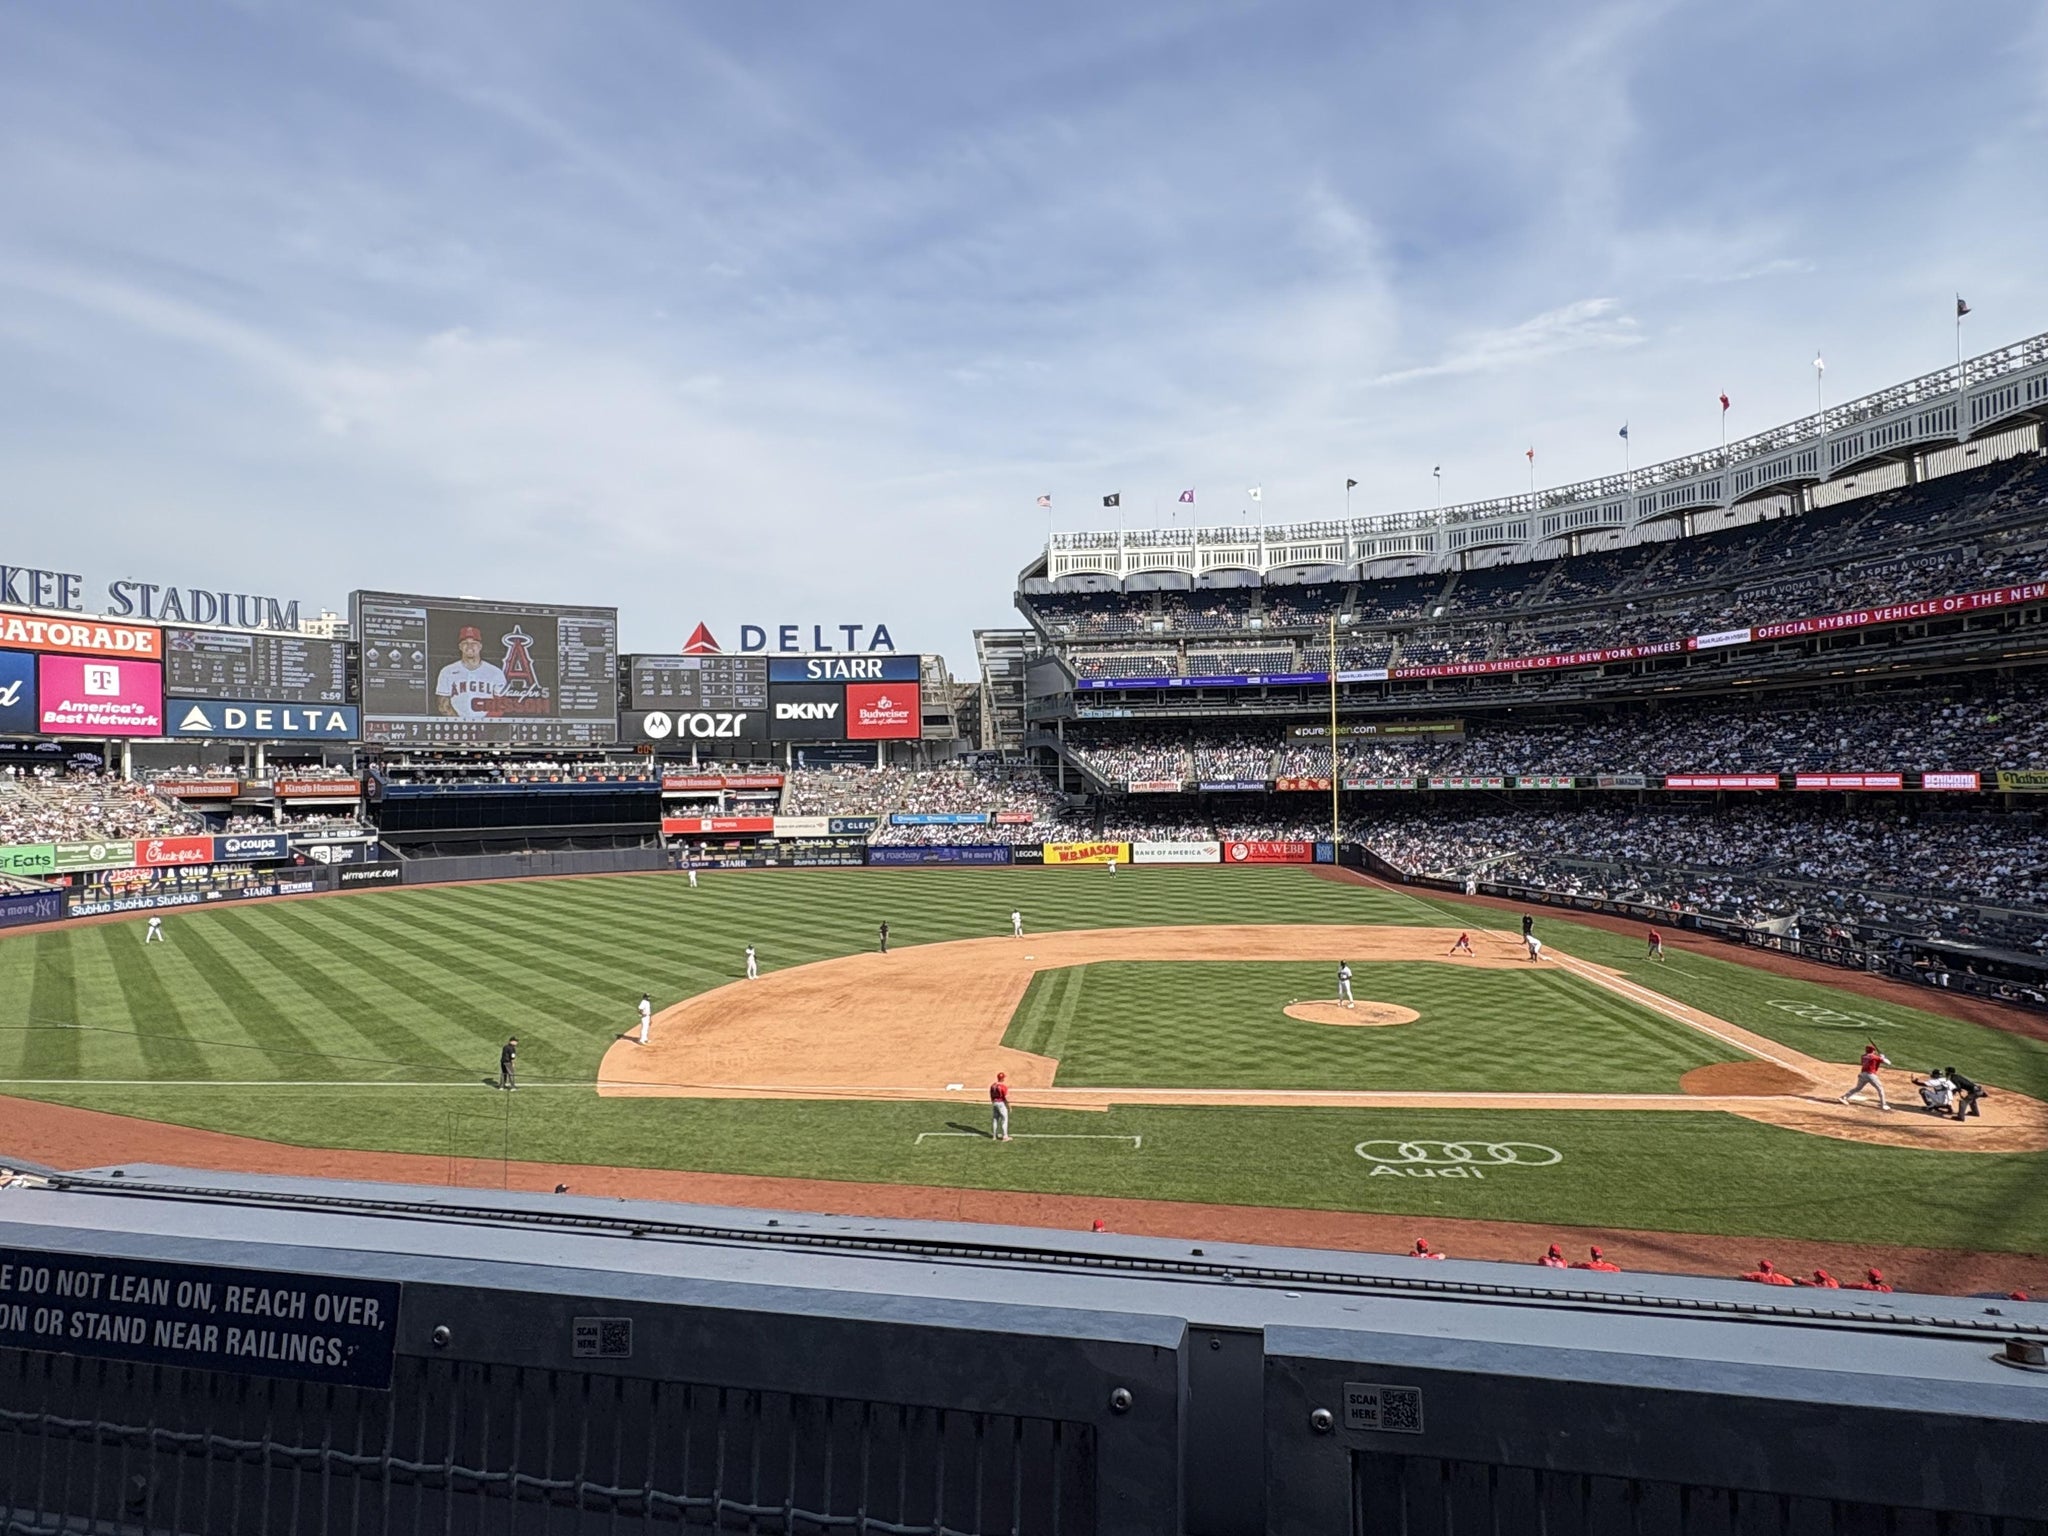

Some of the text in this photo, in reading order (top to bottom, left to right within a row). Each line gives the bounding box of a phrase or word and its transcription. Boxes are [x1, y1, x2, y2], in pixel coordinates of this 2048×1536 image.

[1858, 553, 1954, 578] ASPEN VODKA
[1737, 580, 1813, 601] ASPEN VODKA
[107, 580, 301, 632] STADIUM
[1758, 583, 2046, 638] OFFICIAL HYBRID VEHICLE OF THE NEW
[740, 624, 897, 651] DELTA
[1395, 641, 1682, 678] OFFICIAL HYBRID VEHICLE OF THE NEW YORK YANKEES
[807, 659, 883, 679] STARR
[320, 691, 341, 700] 3:59
[541, 687, 550, 698] 5
[58, 700, 145, 714] America's
[776, 703, 839, 719] DKNY
[859, 709, 909, 719] Budweiser
[43, 712, 158, 726] Best Network
[224, 708, 348, 732] DELTA
[677, 713, 747, 737] razr
[284, 784, 356, 794] King's Hawaiian
[241, 839, 275, 852] coupa
[1250, 844, 1269, 854] F.W.
[1271, 844, 1305, 854] WEBB
[13, 854, 51, 868] Eats
[886, 850, 921, 860] roadway
[243, 887, 273, 898] STARR
[8, 905, 34, 915] move
[72, 894, 198, 916] StubHub StubHub StubHub
[1368, 1165, 1485, 1179] Audi
[18, 1266, 50, 1295] DO
[56, 1269, 105, 1300] NOT
[109, 1274, 170, 1307] LEAN
[177, 1280, 217, 1314] ON,
[225, 1285, 306, 1320] REACH
[314, 1293, 385, 1331] OVER,
[34, 1307, 65, 1336] OR
[70, 1311, 147, 1345] STAND
[153, 1320, 219, 1353] NEAR
[225, 1327, 348, 1367] RAILINGS.
[577, 1327, 598, 1336] SCAN
[577, 1340, 597, 1349] HERE
[1349, 1393, 1378, 1406] SCAN
[1351, 1408, 1377, 1420] HERE
